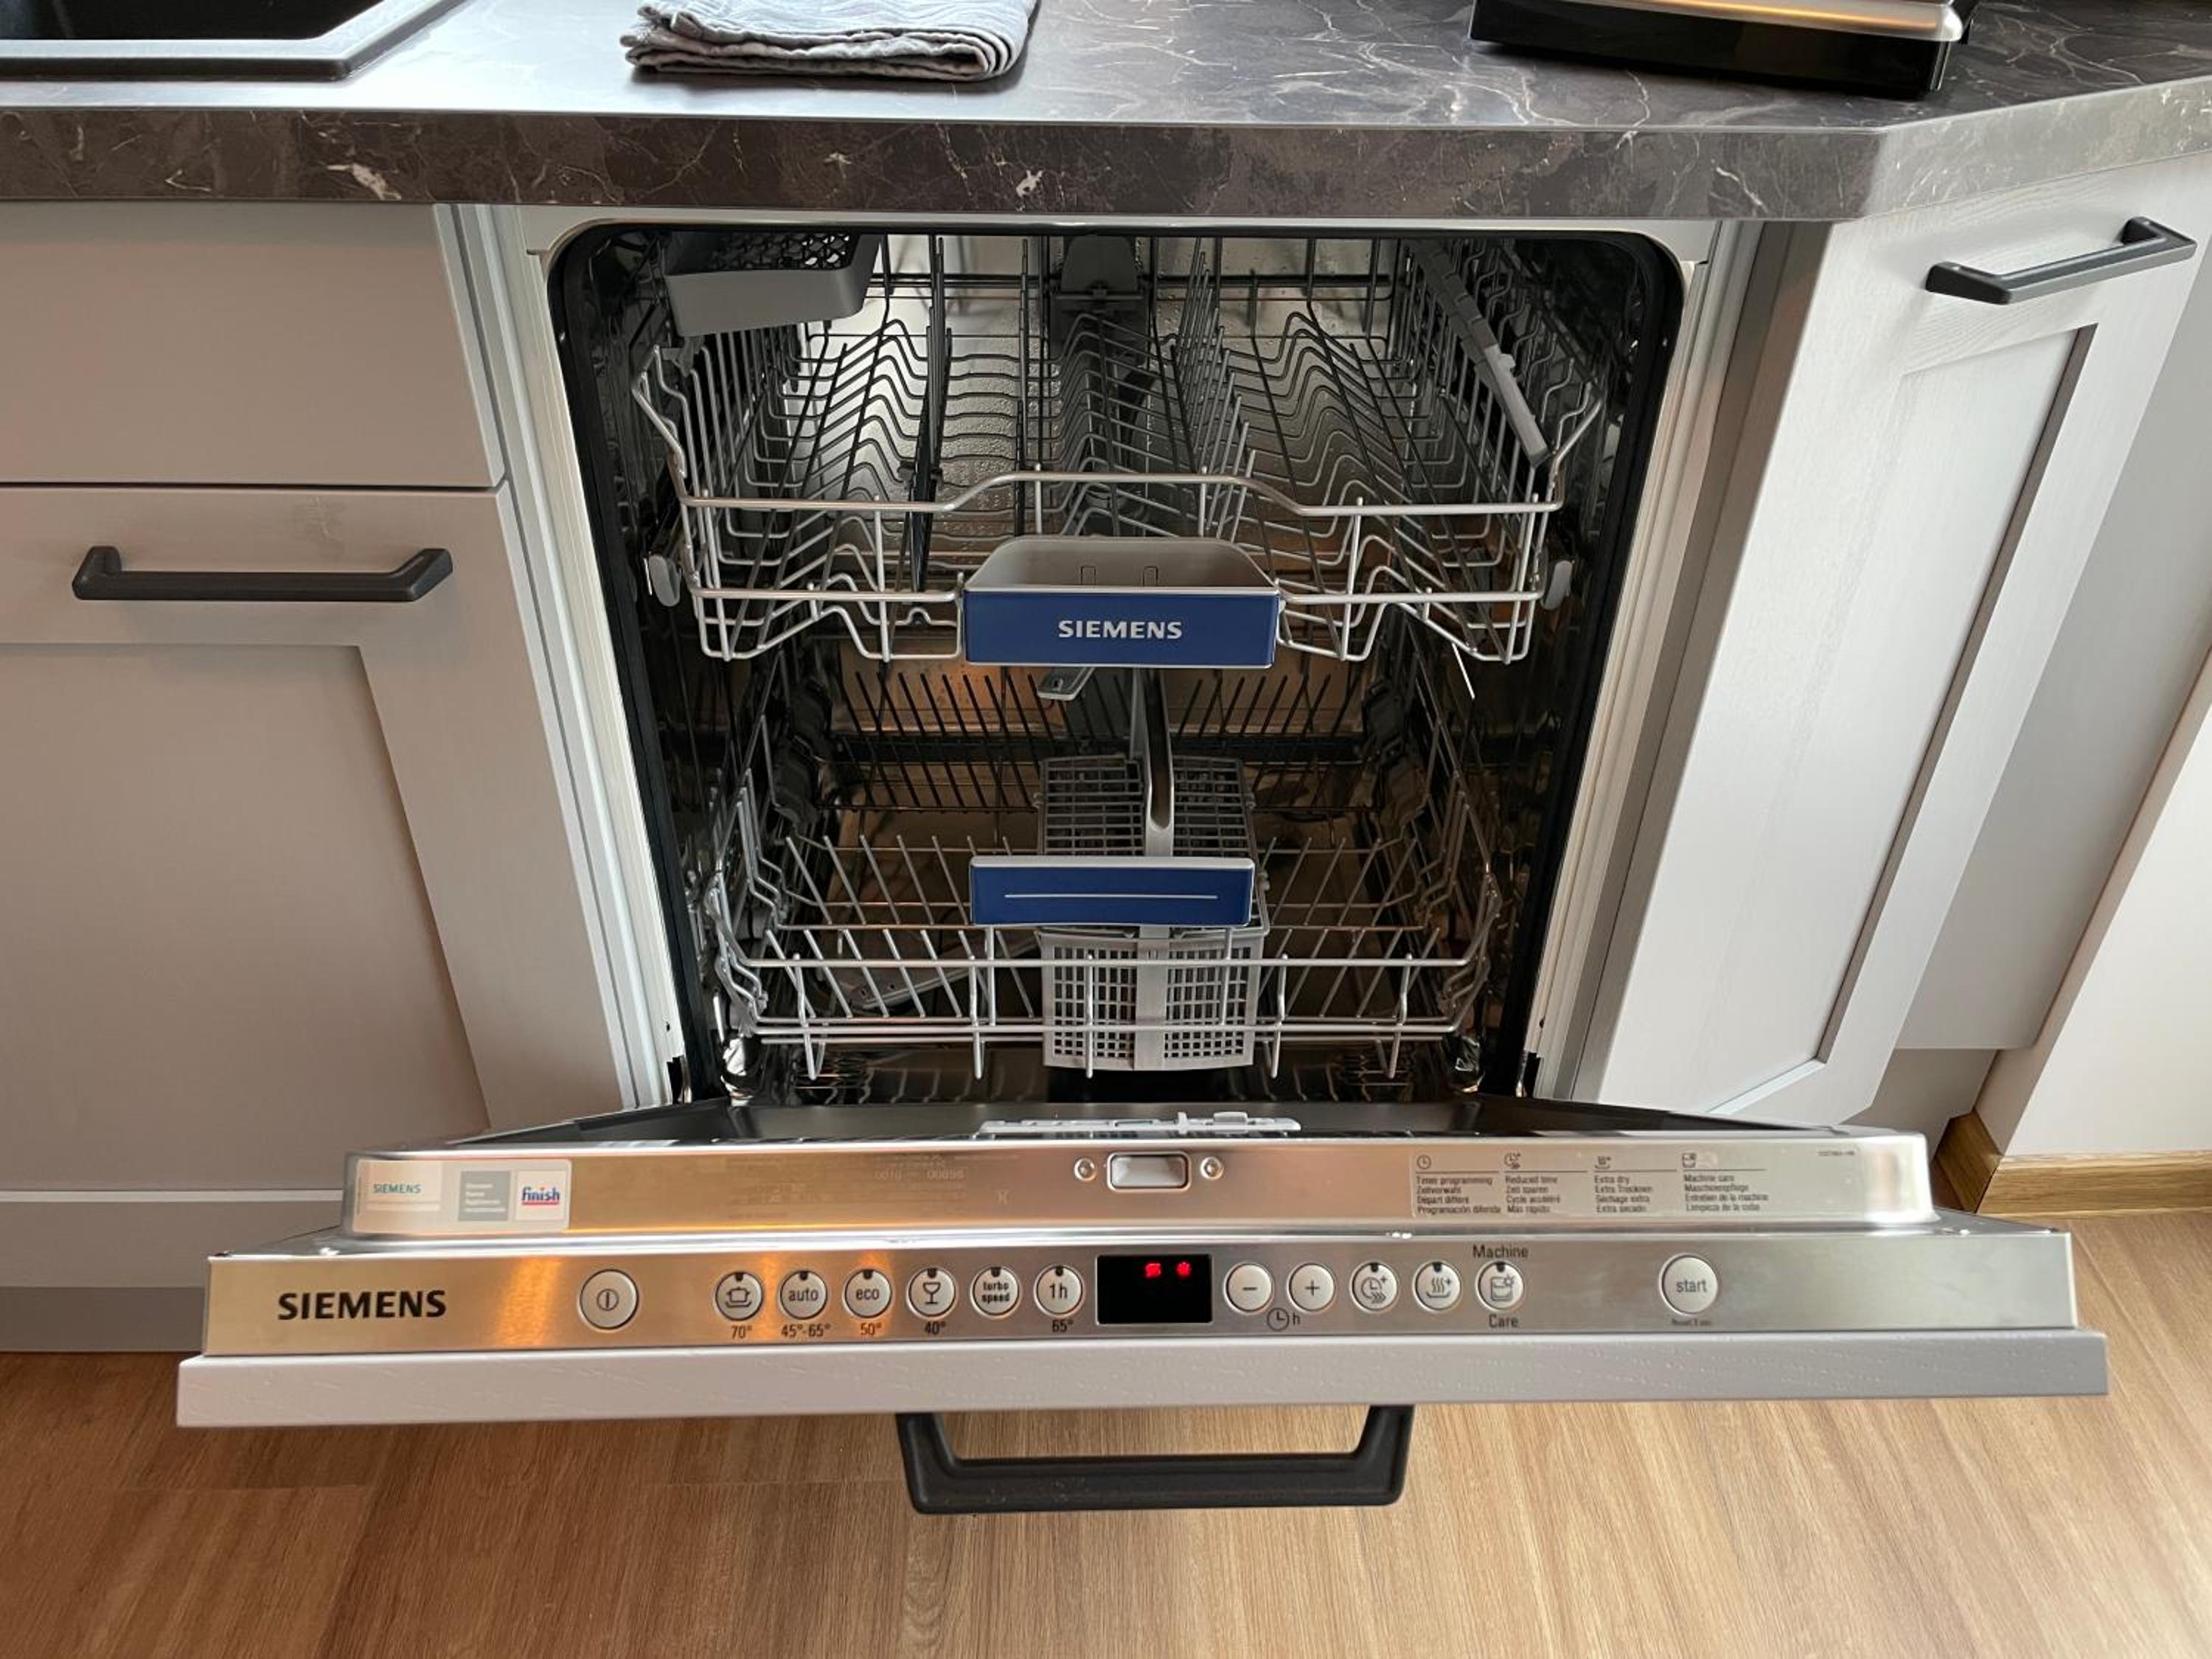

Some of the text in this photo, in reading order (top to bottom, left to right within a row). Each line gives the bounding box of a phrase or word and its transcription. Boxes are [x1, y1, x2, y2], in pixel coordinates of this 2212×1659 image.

[1058, 620, 1183, 639] SIEMENS
[373, 1183, 421, 1194] SIEMENS
[521, 1186, 560, 1201] finish
[1472, 1245, 1528, 1258] Machine
[983, 1281, 1009, 1291] turbo
[1676, 1279, 1708, 1293] start
[788, 1287, 819, 1302] auto
[855, 1288, 880, 1301] eco
[981, 1293, 1011, 1304] speed
[277, 1290, 448, 1321] SIEMENS
[1292, 1313, 1301, 1326] h
[1488, 1315, 1519, 1328] Care
[731, 1325, 753, 1339] 70°
[860, 1323, 883, 1336] 50°
[924, 1321, 946, 1335] 40°
